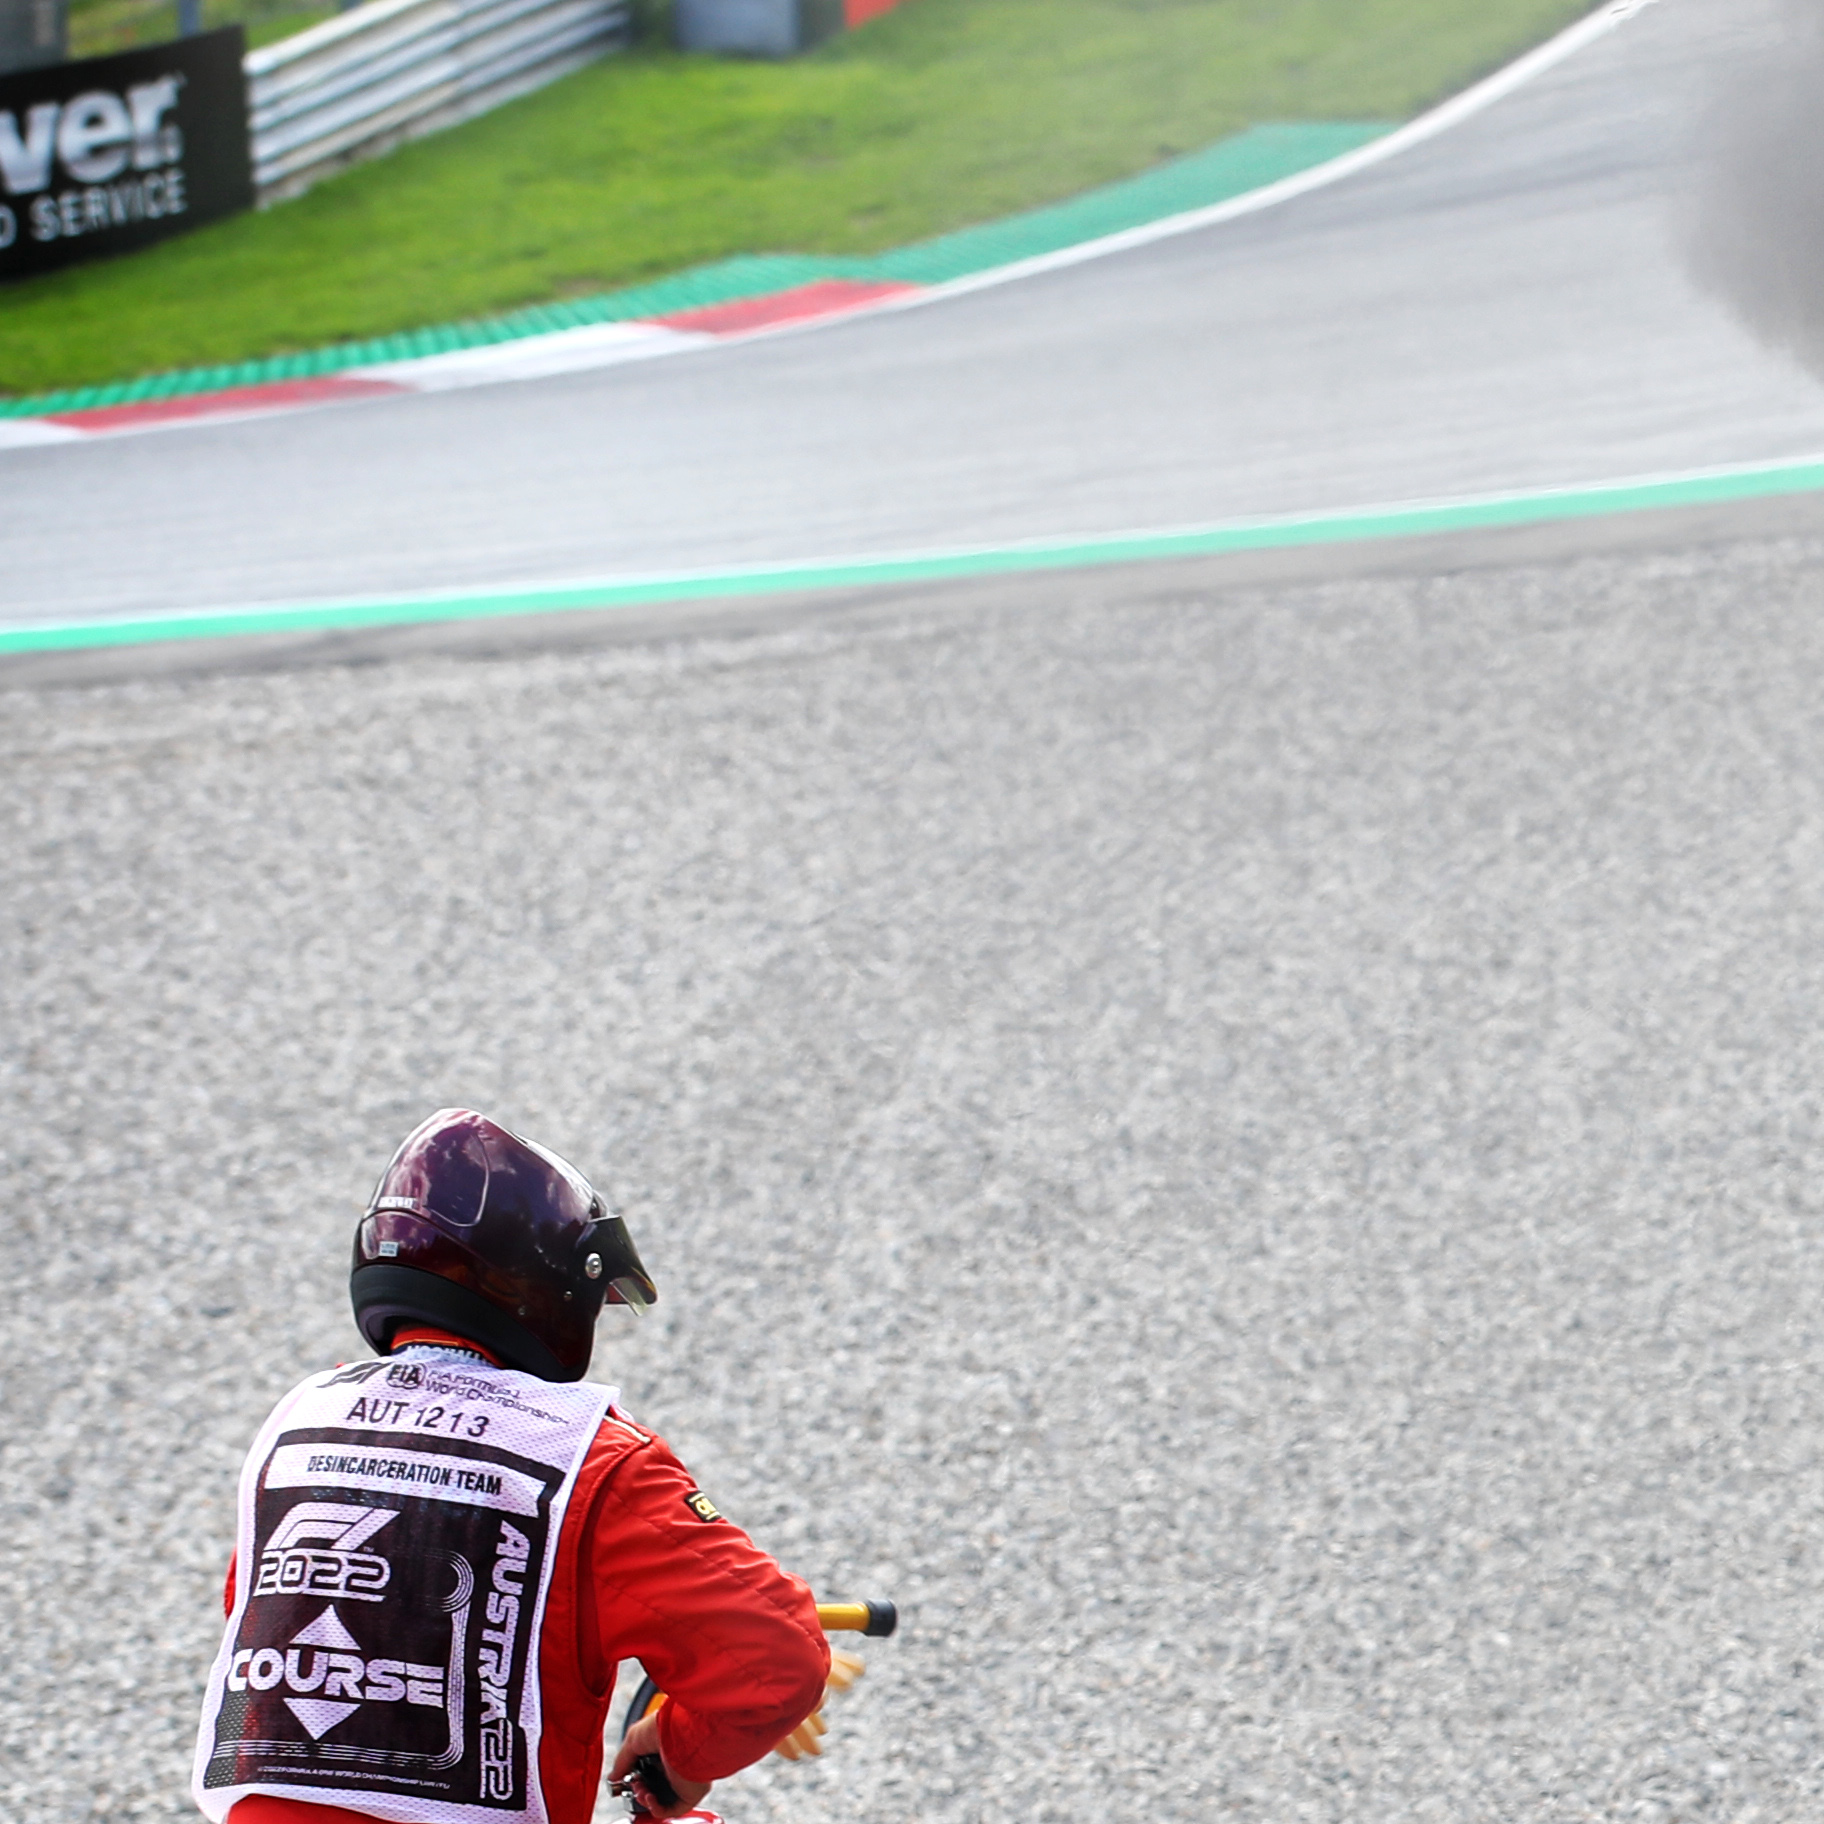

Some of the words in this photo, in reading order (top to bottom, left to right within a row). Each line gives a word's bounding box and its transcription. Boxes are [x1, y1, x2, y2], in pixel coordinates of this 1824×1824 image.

[30, 169, 187, 241] SERVICE
[347, 1397, 409, 1426] AUT
[306, 1454, 450, 1486] DESINCARCERATION
[455, 1469, 503, 1495] TEAM
[252, 1547, 391, 1602] 2022
[227, 1647, 445, 1710] COURSE
